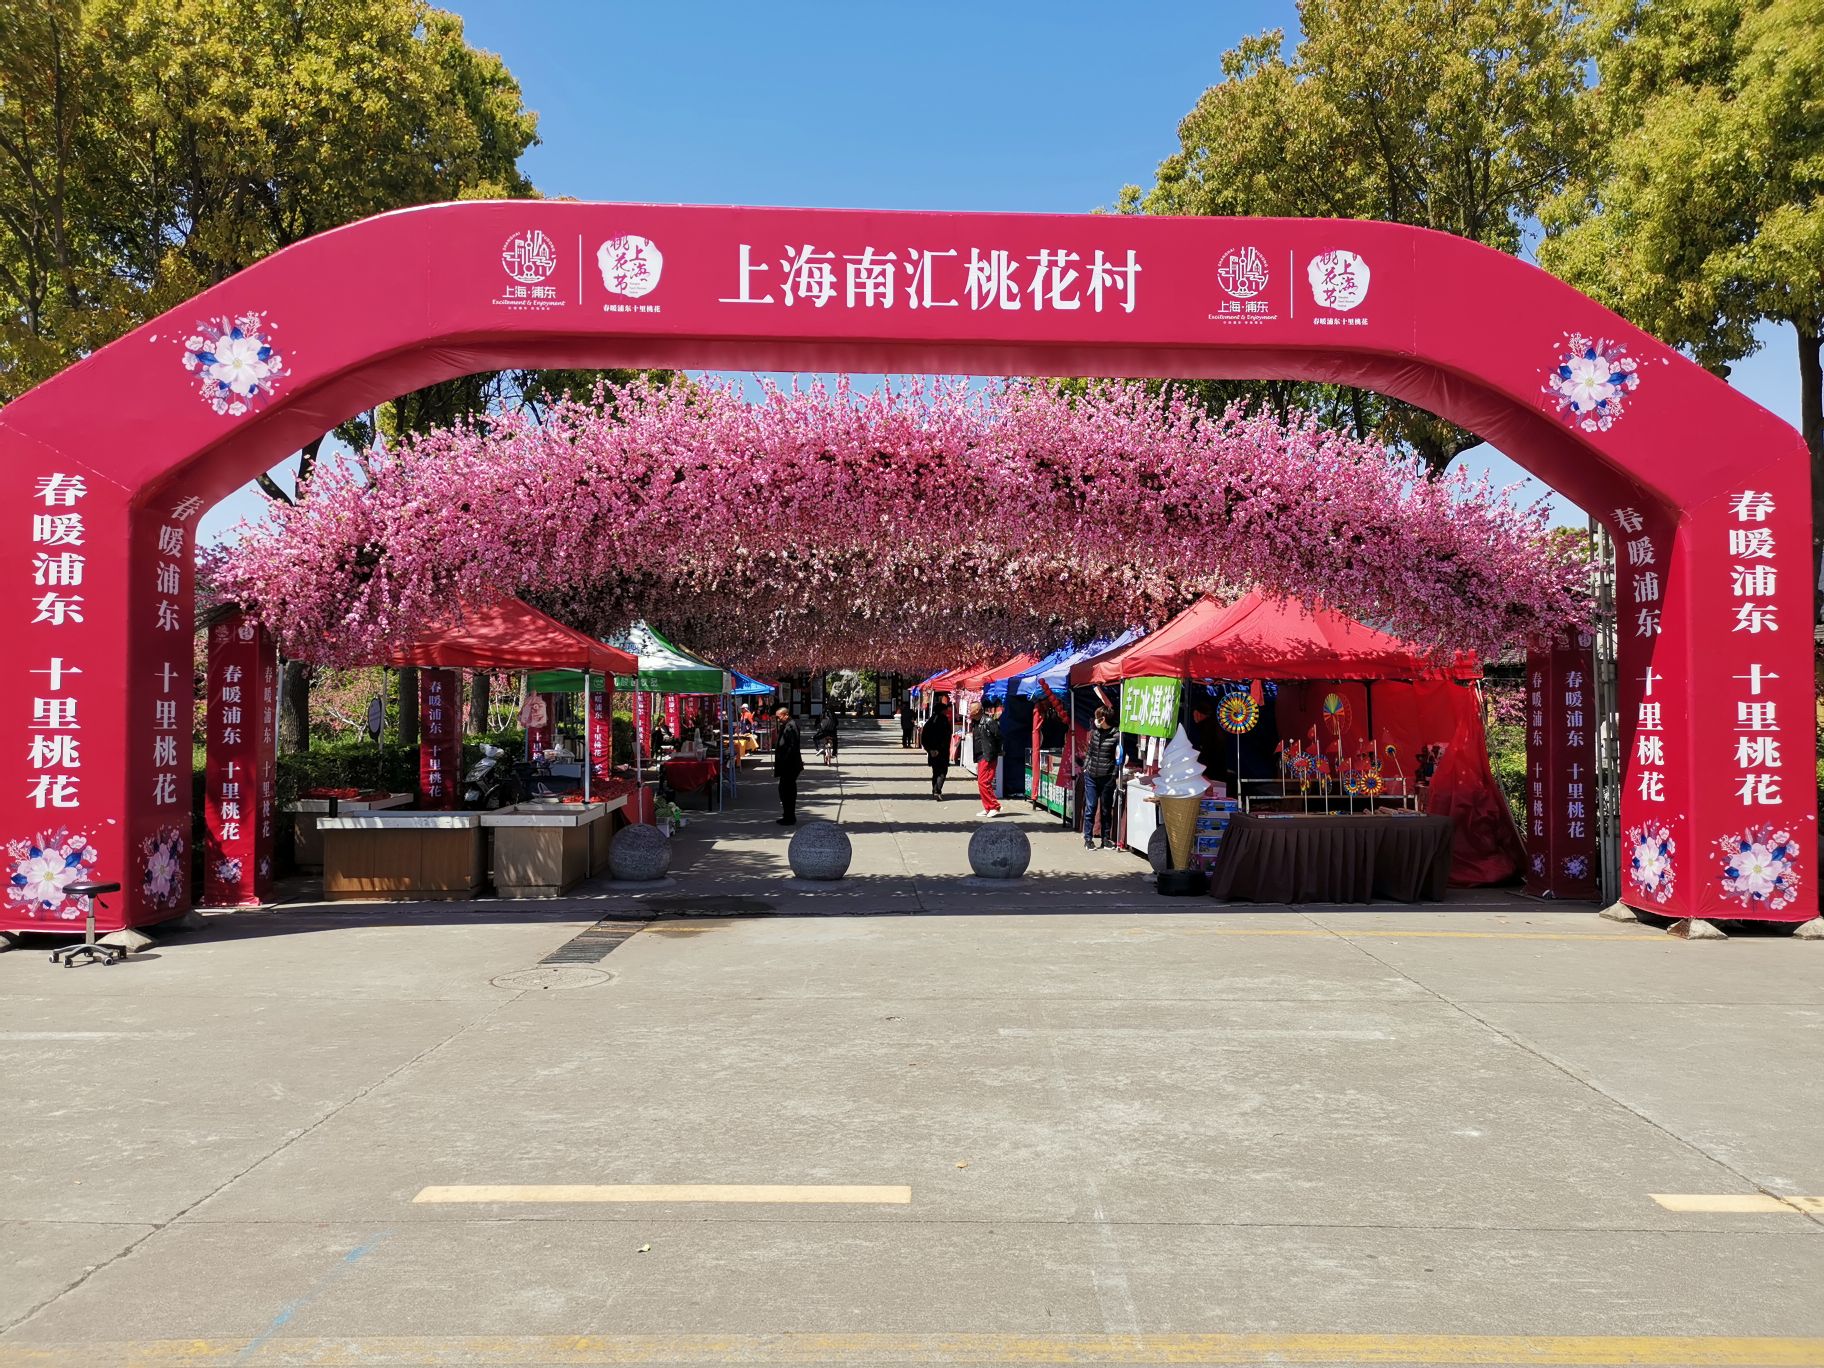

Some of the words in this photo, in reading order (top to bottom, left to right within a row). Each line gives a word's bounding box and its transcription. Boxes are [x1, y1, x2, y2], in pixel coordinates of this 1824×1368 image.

[492, 299, 526, 307] Excitement
[533, 300, 566, 308] Enjoyment
[502, 285, 556, 299] 上海·浦东
[718, 243, 1143, 314] 上海南汇桃花村
[1217, 300, 1269, 313] 上海·浦东
[1246, 314, 1278, 322] Enjoyment
[31, 471, 88, 626] 春暖浦东
[155, 494, 204, 634] 春暖浦东
[1610, 507, 1662, 638] 春暖浦东
[1728, 490, 1779, 634] 春暖浦东
[26, 657, 83, 809] 十里桃花
[152, 661, 180, 806] 十里桃花
[222, 665, 242, 745] 春暖浦东
[428, 680, 442, 734] 春暖浦东
[1531, 671, 1543, 747] 春暖浦东
[1565, 671, 1584, 747] 春暖浦东
[1635, 666, 1665, 802] 十里桃花
[1732, 663, 1783, 806] 十里桃花
[220, 761, 241, 841] 十里桃花
[428, 745, 442, 797] 十里桃花
[1533, 761, 1544, 837] 十里桃花
[1566, 762, 1585, 839] 十里桃花
